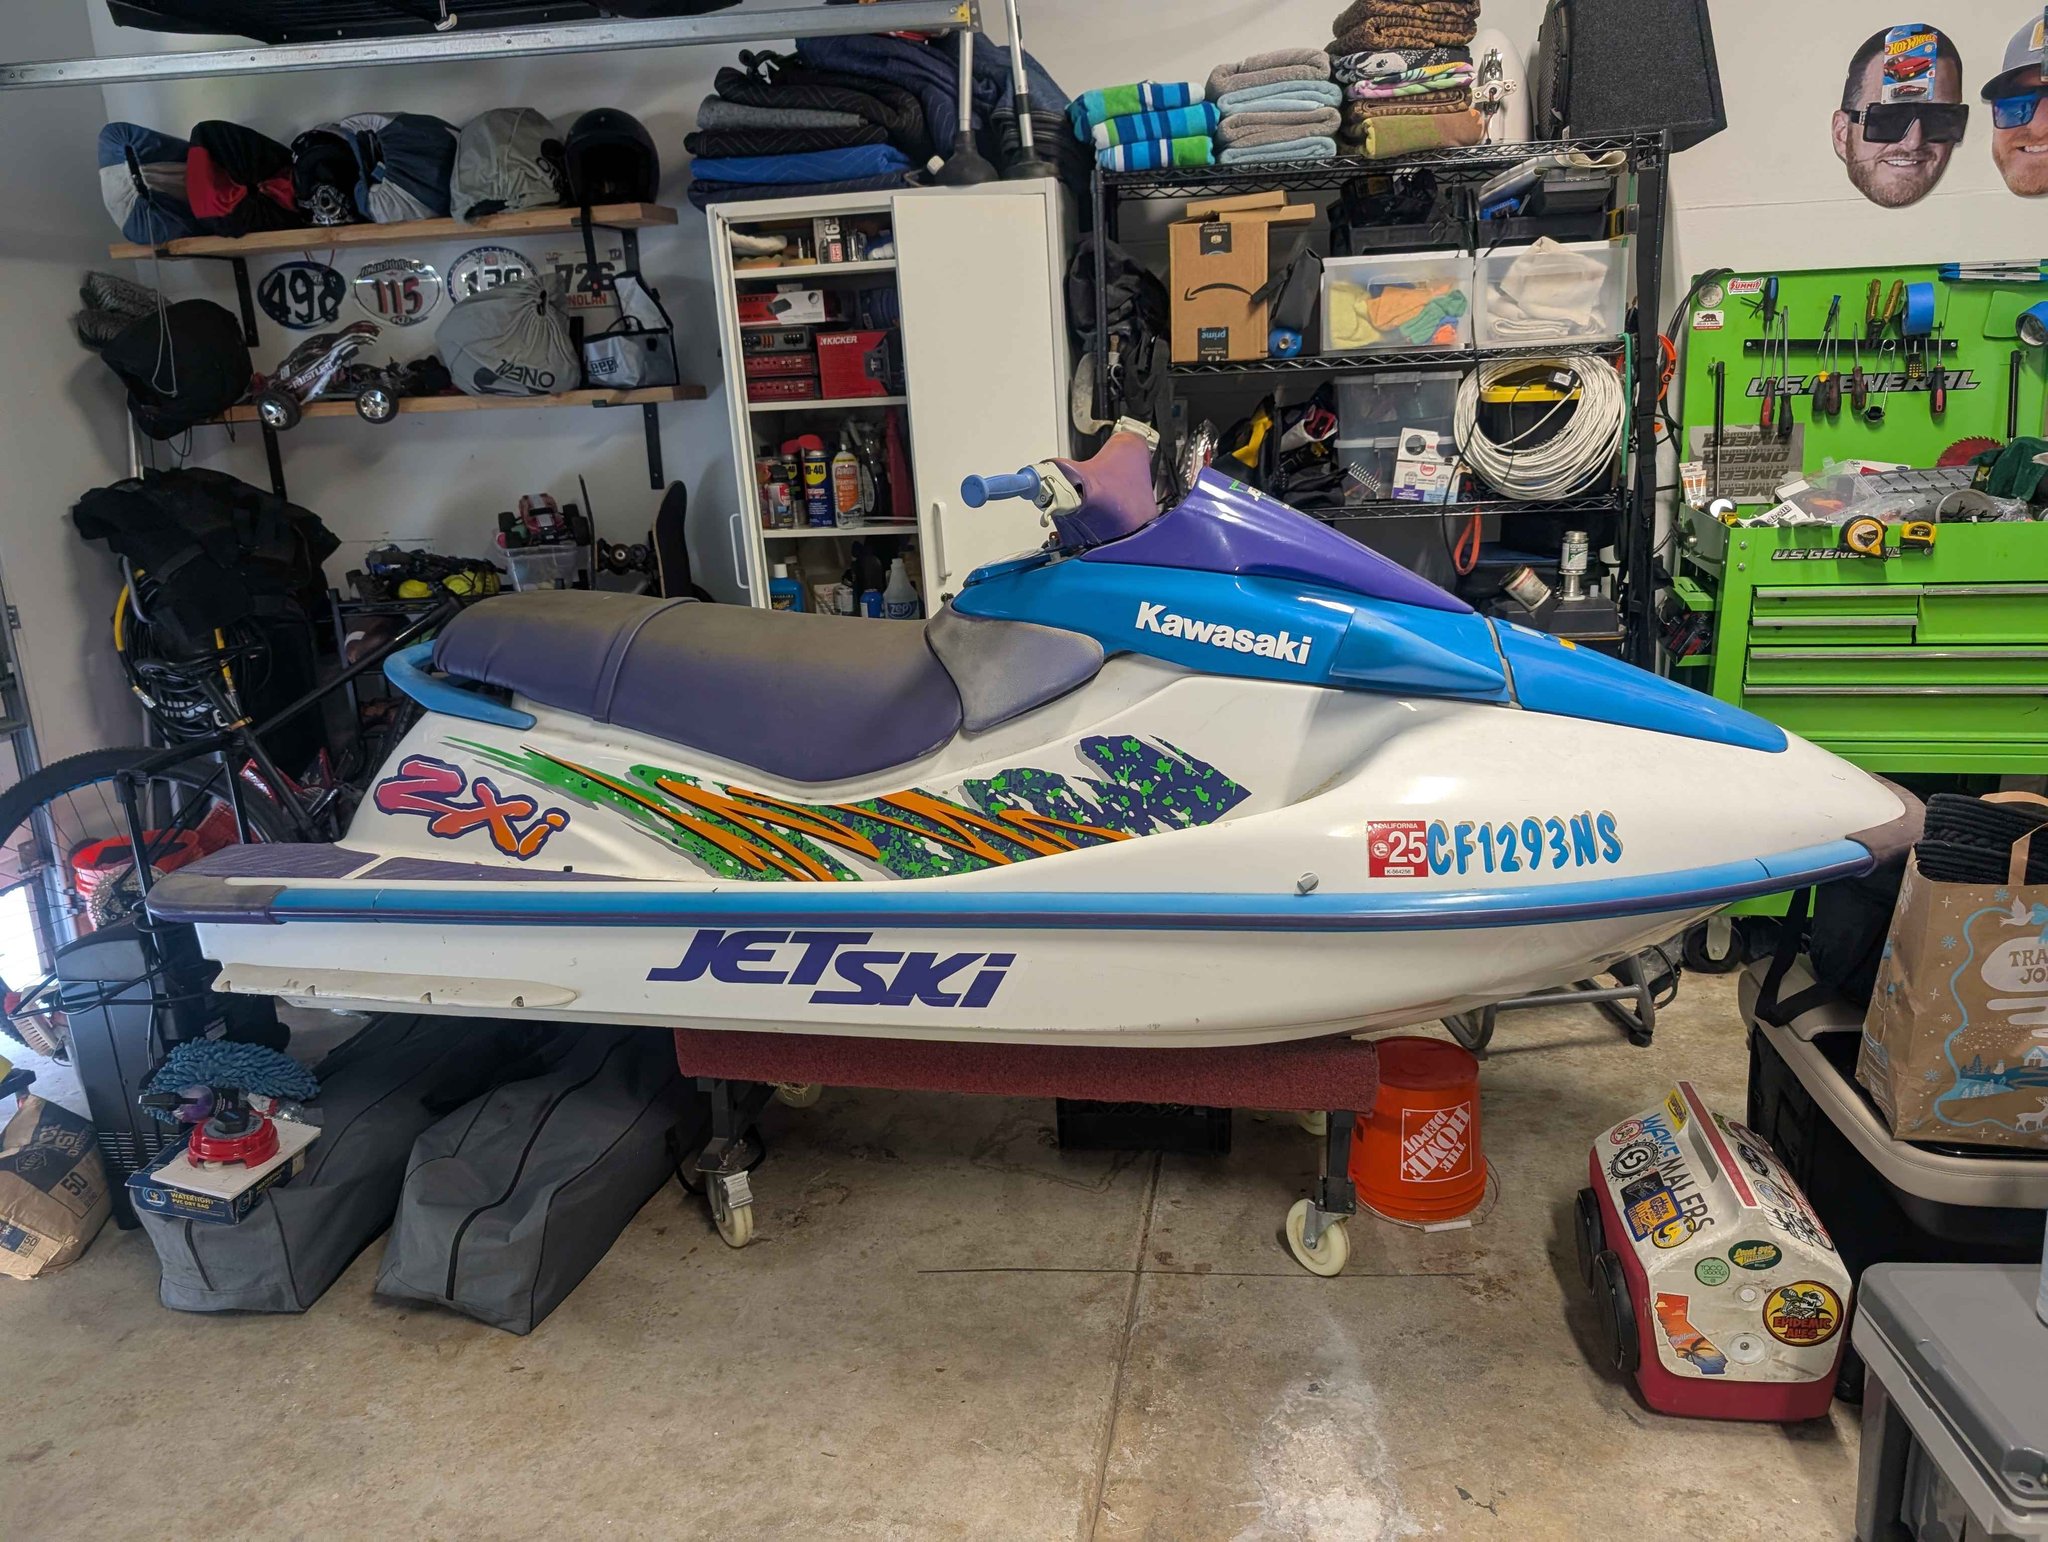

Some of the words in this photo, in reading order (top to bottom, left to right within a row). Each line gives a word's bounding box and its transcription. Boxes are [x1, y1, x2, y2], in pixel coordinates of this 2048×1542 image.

[1888, 39, 1909, 56] HOT
[555, 261, 616, 293] 726
[371, 275, 424, 315] 115
[824, 335, 858, 346] KICKER
[1201, 330, 1227, 341] prime
[804, 463, 825, 476] D-40
[1771, 549, 1806, 561] U.S.
[1135, 601, 1313, 665] Kawasaki
[1388, 831, 1427, 865] 25
[1427, 810, 1625, 876] CF1293NS
[645, 929, 874, 986] JET
[2019, 967, 2048, 985] JO
[1402, 1106, 1470, 1182] HOME
[1403, 1110, 1449, 1156] DEPOT
[1641, 1112, 1681, 1158] WAKE
[1439, 1141, 1467, 1173] THE
[61, 1171, 89, 1196] 50
[23, 1234, 38, 1247] 50
[1773, 1316, 1833, 1330] EPIDEMIC
[1785, 1328, 1818, 1340] ALES
